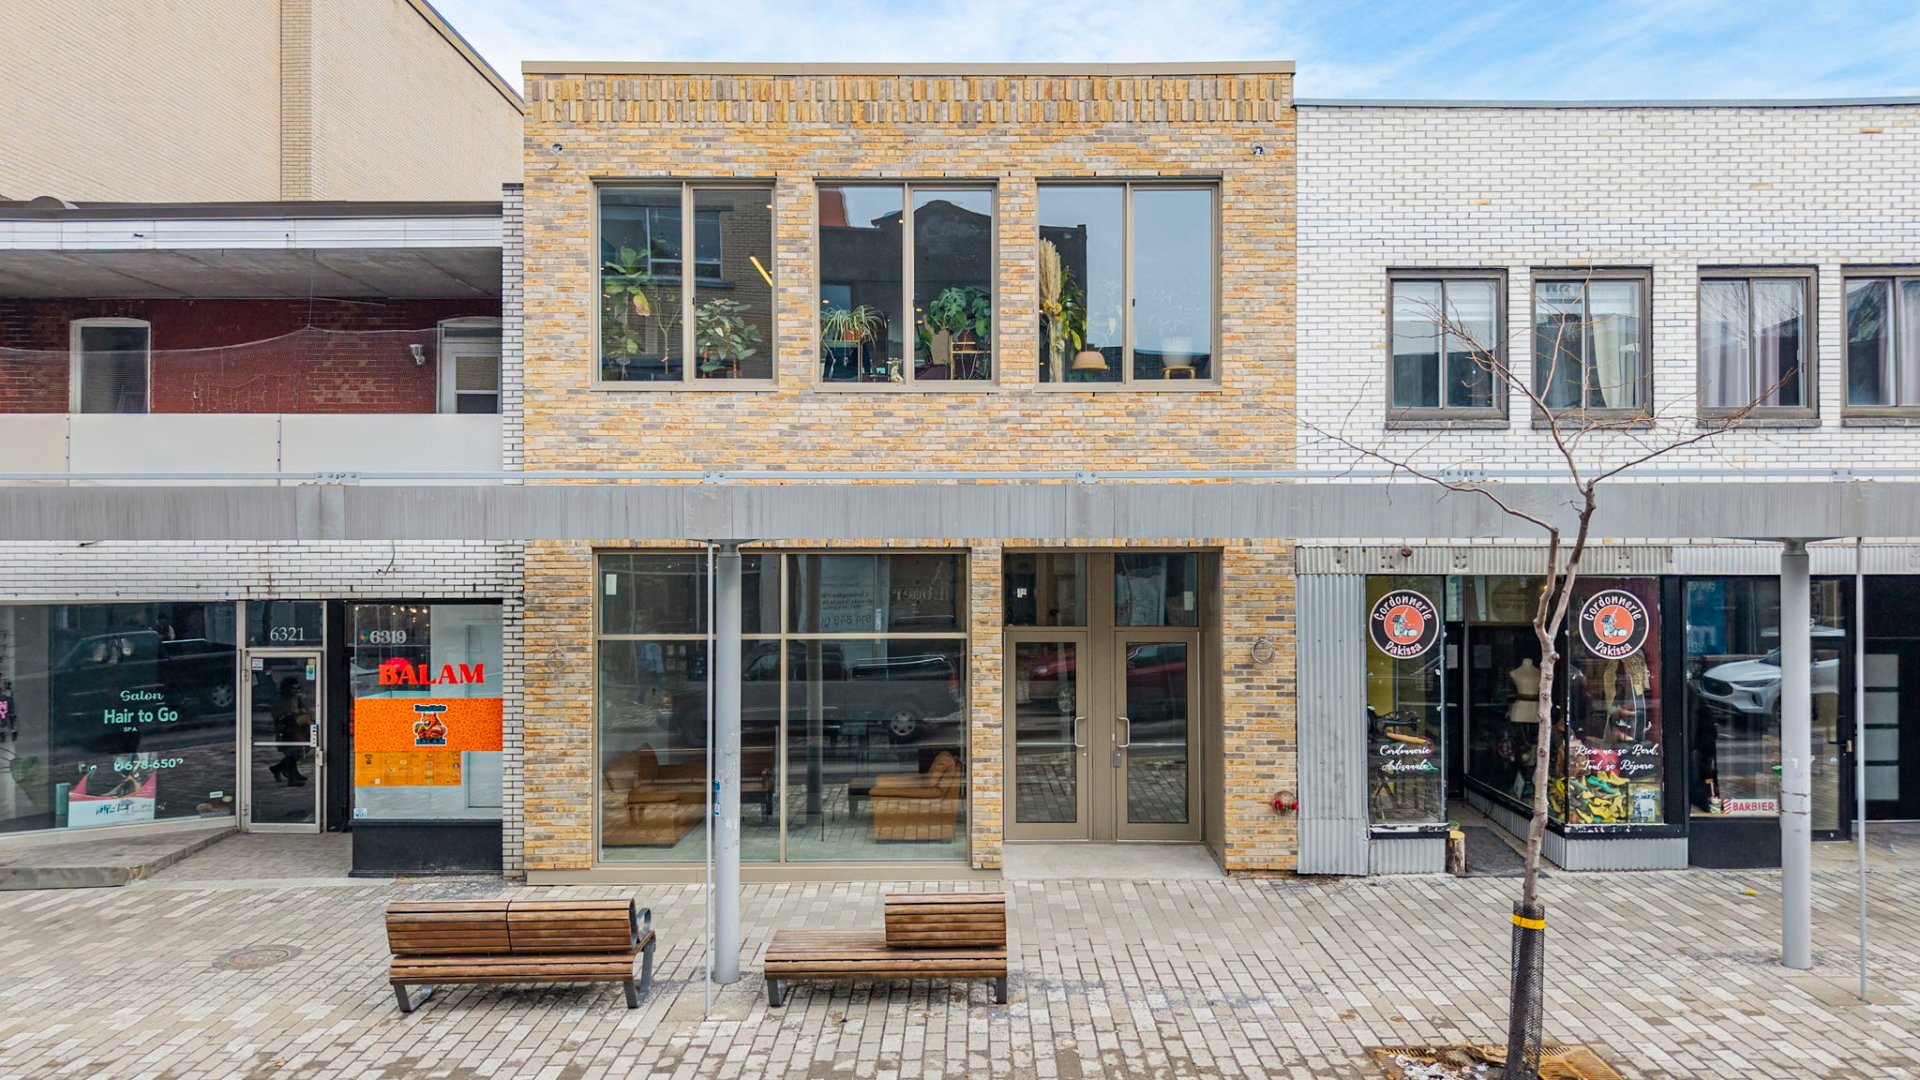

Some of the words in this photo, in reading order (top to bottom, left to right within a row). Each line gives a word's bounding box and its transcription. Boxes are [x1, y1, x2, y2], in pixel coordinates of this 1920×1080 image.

[1373, 595, 1432, 621] Cordonnerie
[1583, 595, 1642, 621] Cordonnerie
[270, 626, 304, 641] 6321
[369, 629, 407, 644] 6319
[377, 663, 485, 685] BALAM
[120, 690, 165, 701] Salon
[103, 709, 134, 724] Hair
[138, 709, 154, 723] to
[157, 707, 178, 722] Go
[1379, 743, 1432, 756] Cordonnerie
[1575, 744, 1598, 756] Rien
[1617, 748, 1629, 756] se
[1381, 759, 1435, 772] Artisanale
[1583, 759, 1602, 771] Tout
[1606, 763, 1617, 772] se
[1732, 801, 1775, 811] BARBIER
